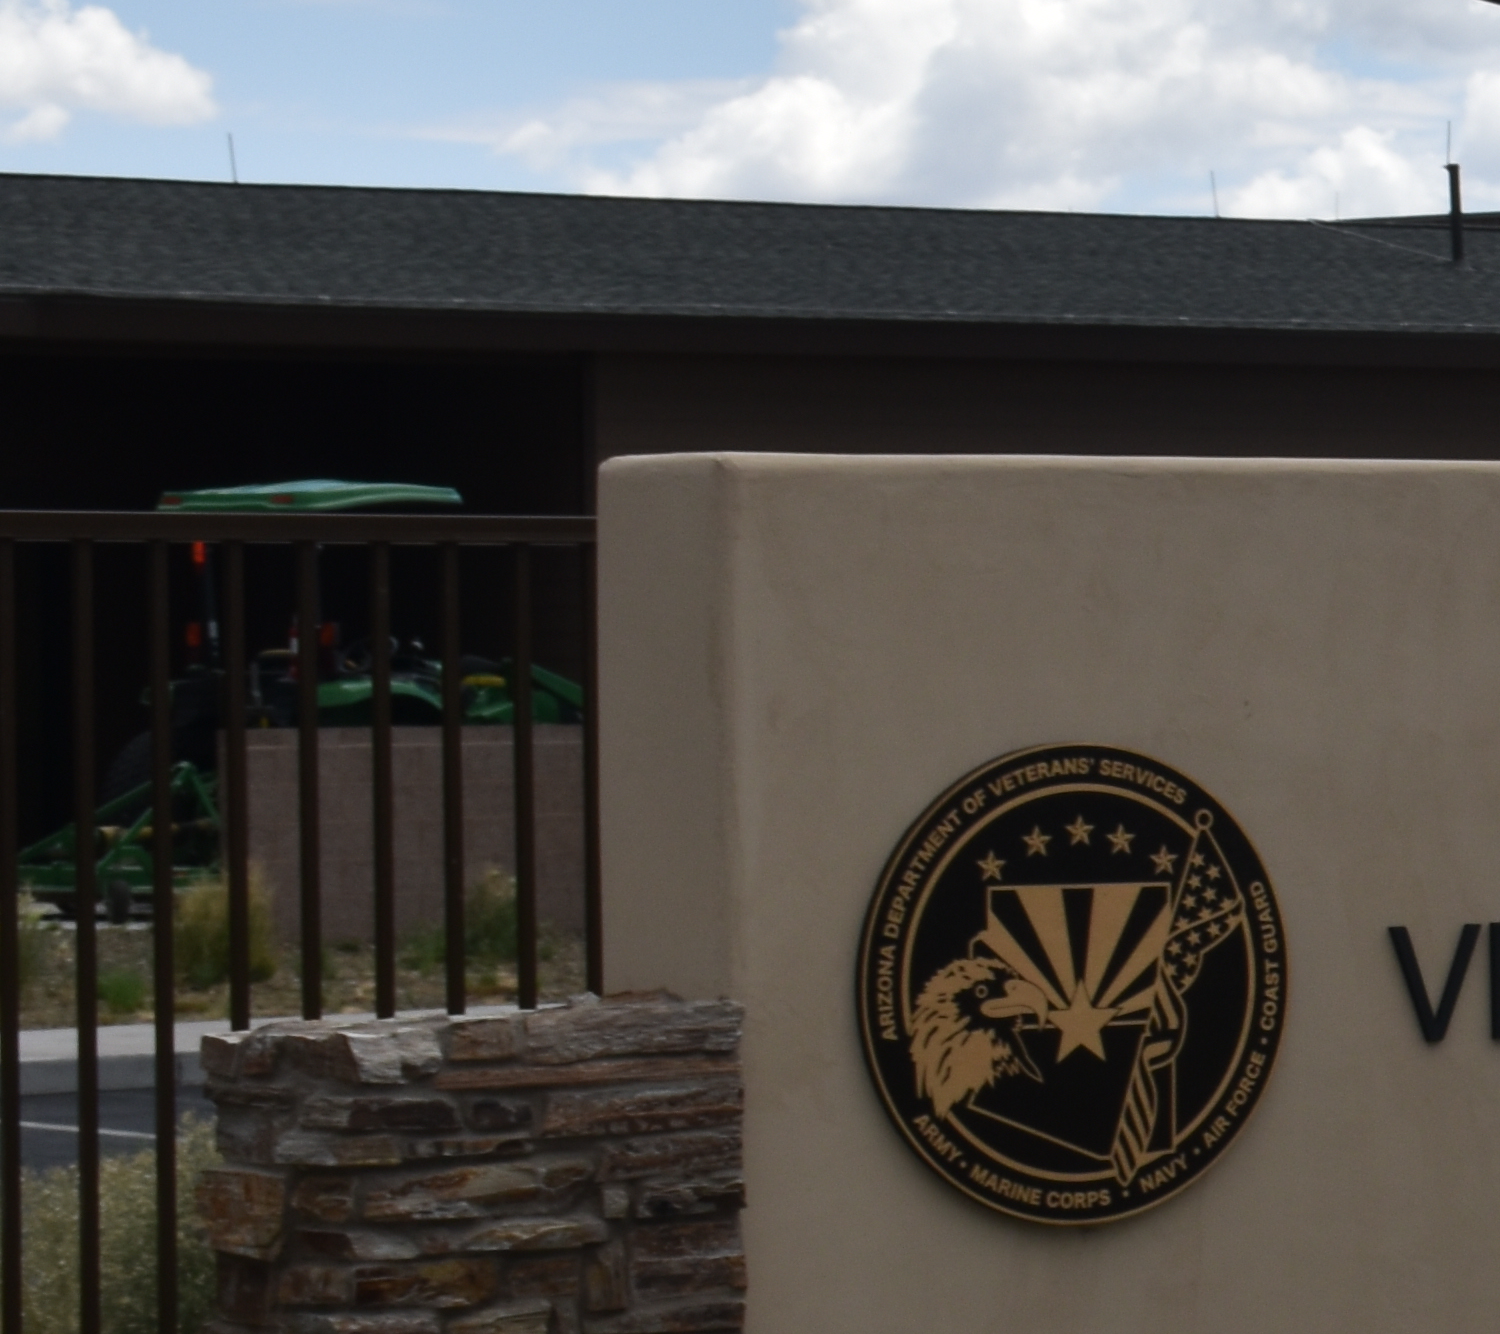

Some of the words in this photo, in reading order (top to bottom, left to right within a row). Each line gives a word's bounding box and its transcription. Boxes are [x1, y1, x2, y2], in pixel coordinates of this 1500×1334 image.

[988, 757, 1095, 796] VETERANS'
[1099, 759, 1187, 805] SERVICES
[964, 790, 987, 815] OF
[884, 811, 962, 940] DEPARTMENT
[1250, 880, 1278, 953] GUARD
[880, 946, 898, 1041] ARIZONA
[1260, 959, 1280, 1031] COAST
[1226, 1051, 1267, 1117] FORCE
[913, 1114, 961, 1161] ARMY
[1204, 1115, 1230, 1149] AIR
[970, 1164, 1041, 1206] MARINE
[1047, 1188, 1111, 1210] CORPS
[1140, 1158, 1188, 1194] NAVY
